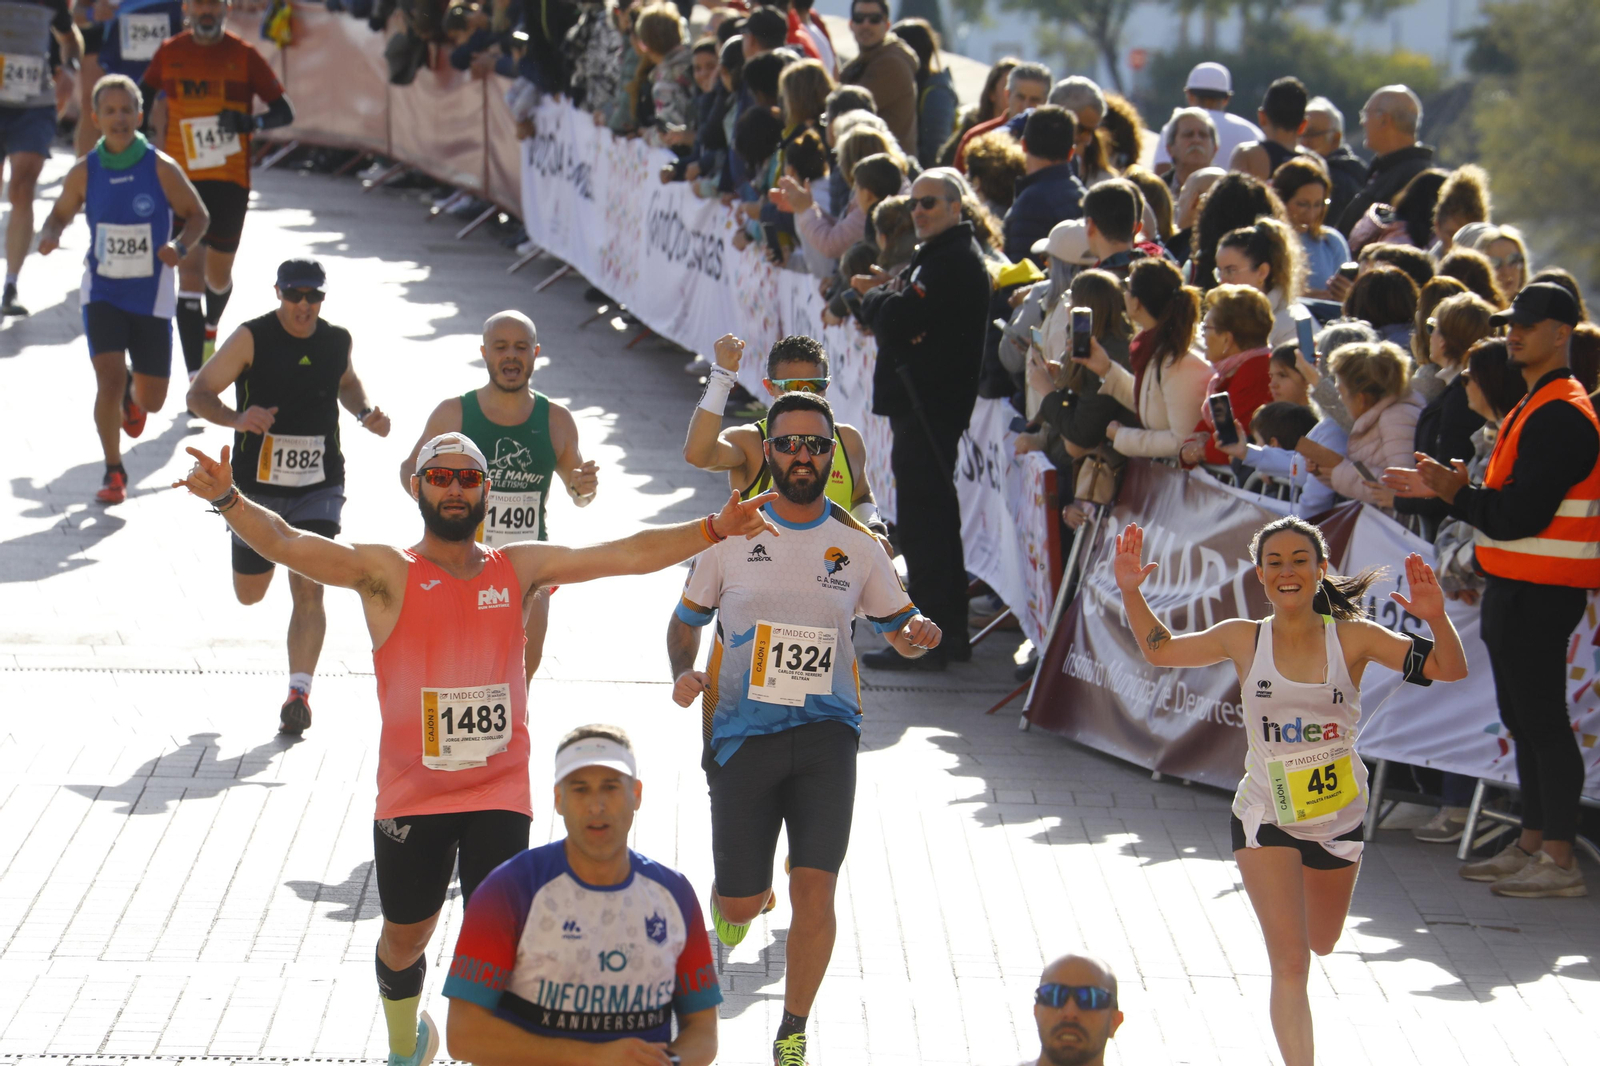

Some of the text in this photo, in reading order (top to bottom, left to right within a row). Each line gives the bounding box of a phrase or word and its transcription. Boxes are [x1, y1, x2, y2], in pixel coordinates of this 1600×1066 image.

[107, 236, 148, 255] 3284
[273, 448, 321, 469] 1882
[487, 469, 544, 485] CE MAMUT
[495, 495, 521, 503] IMDECO
[487, 506, 536, 529] 1490
[782, 629, 816, 639] IMDECO
[756, 646, 765, 672] CAJÓN
[771, 641, 832, 673] 1324
[449, 690, 485, 700] IMDECO
[1174, 681, 1245, 729] Deportes
[441, 703, 507, 735] 1483
[1262, 716, 1340, 743] indea
[1294, 752, 1329, 766] IMDECO
[1307, 763, 1338, 795] 45
[1276, 783, 1288, 810] CAJÓN
[598, 950, 627, 972] 10
[541, 1011, 664, 1031] X ANIVERSARIO
